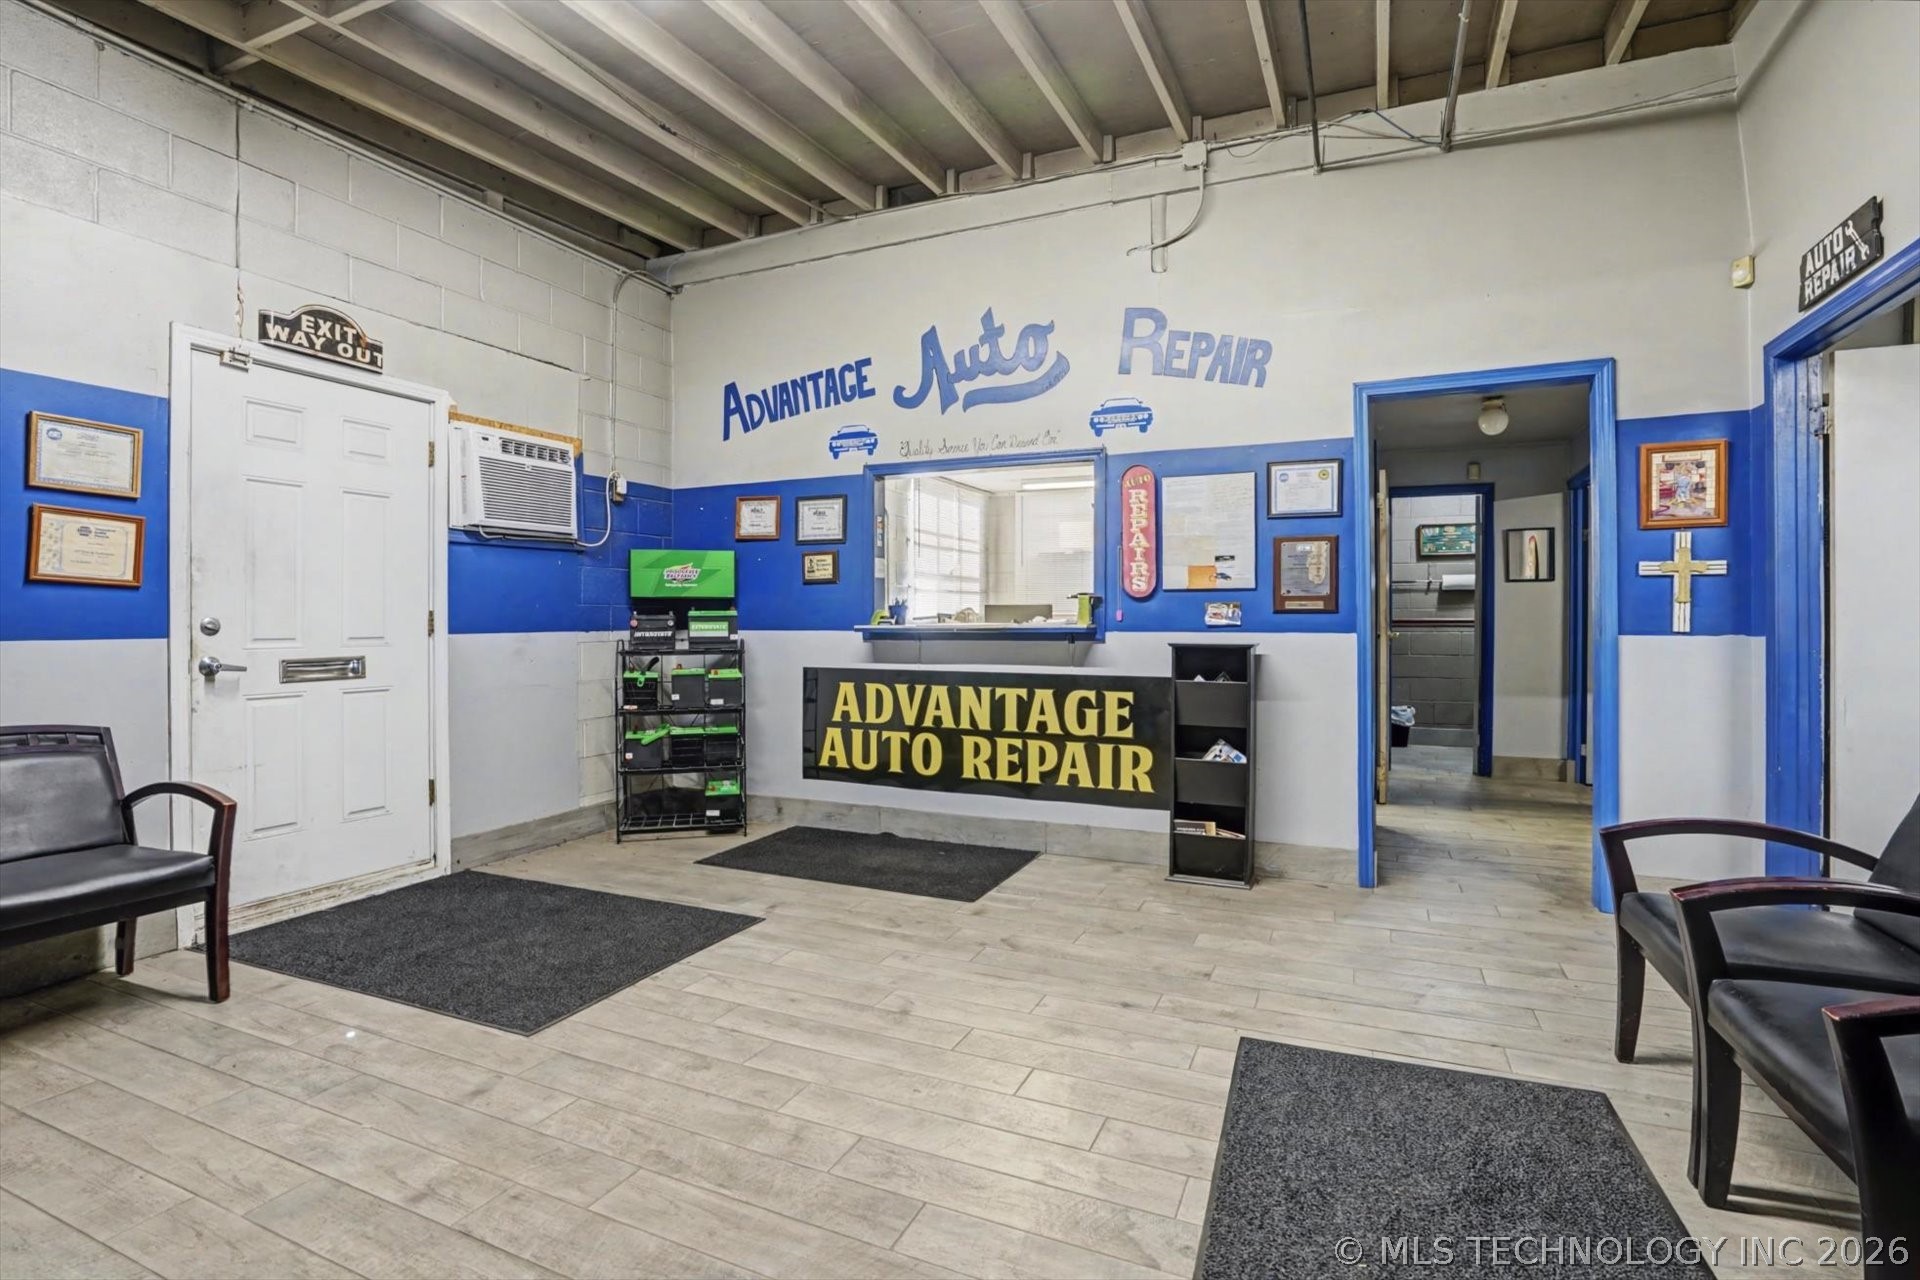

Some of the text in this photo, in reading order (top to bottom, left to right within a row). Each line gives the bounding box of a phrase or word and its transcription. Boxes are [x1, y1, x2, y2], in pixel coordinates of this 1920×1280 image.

[1804, 244, 1857, 305] REPAIR
[1805, 225, 1844, 278] AUTO
[265, 322, 383, 368] WAY OUT
[301, 314, 358, 345] EXIT
[722, 307, 1273, 442] ADVANTAGE Auto REPAIR
[1128, 489, 1151, 592] REPAIRS
[831, 682, 1135, 738] ADVANTAGE
[818, 727, 1156, 793] AUTO REPAIR
